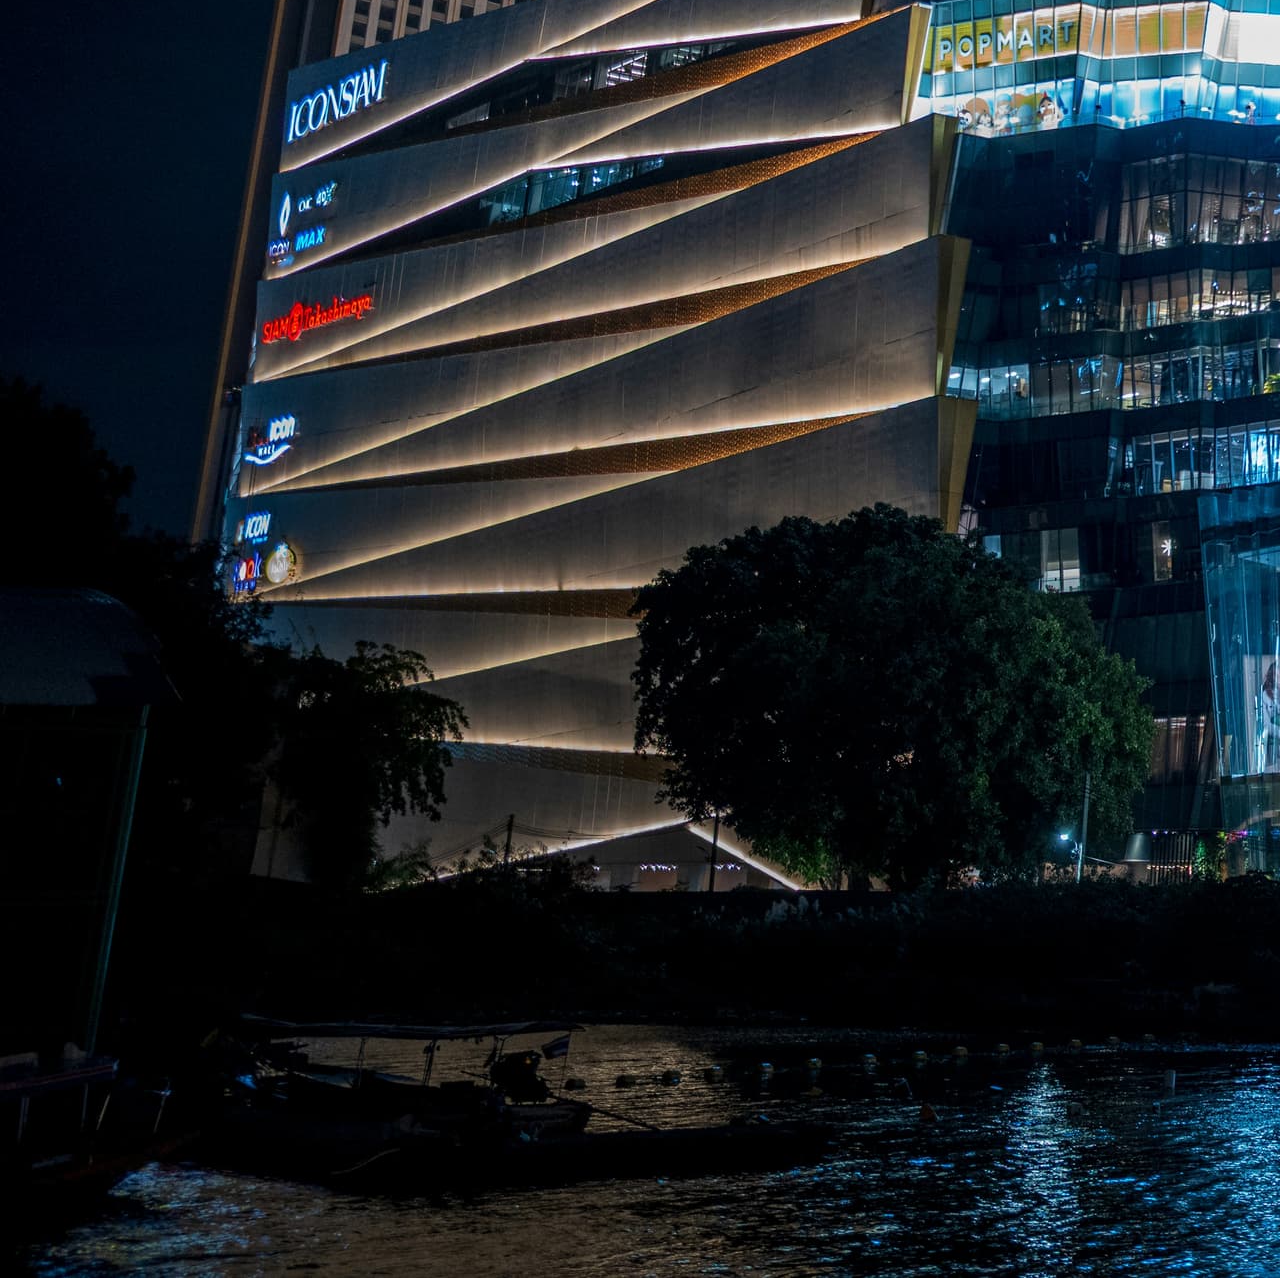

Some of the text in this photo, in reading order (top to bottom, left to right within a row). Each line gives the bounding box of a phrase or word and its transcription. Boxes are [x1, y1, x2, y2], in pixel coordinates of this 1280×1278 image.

[287, 61, 388, 143] ICONSIAM
[268, 240, 290, 257] ICON
[295, 226, 326, 252] IMAX
[262, 318, 290, 343] SIAM
[302, 295, 372, 330] Takashimaya
